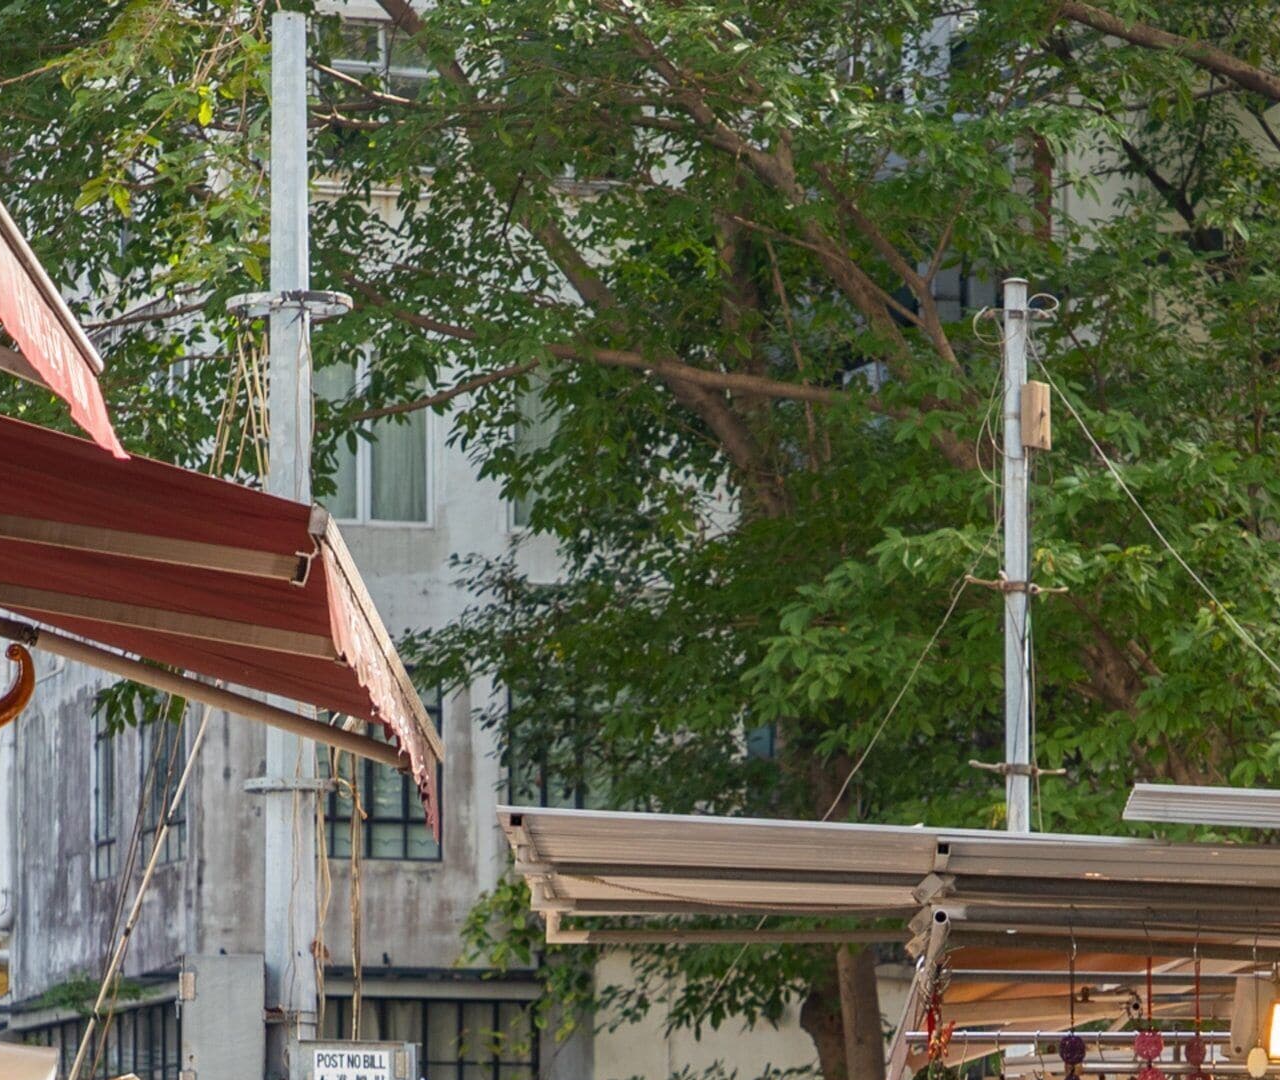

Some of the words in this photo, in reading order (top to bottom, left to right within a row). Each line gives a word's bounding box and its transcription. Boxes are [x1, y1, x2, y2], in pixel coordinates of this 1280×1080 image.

[317, 1053, 345, 1069] POST
[347, 1053, 361, 1069] NO
[363, 1053, 386, 1070] BILL
